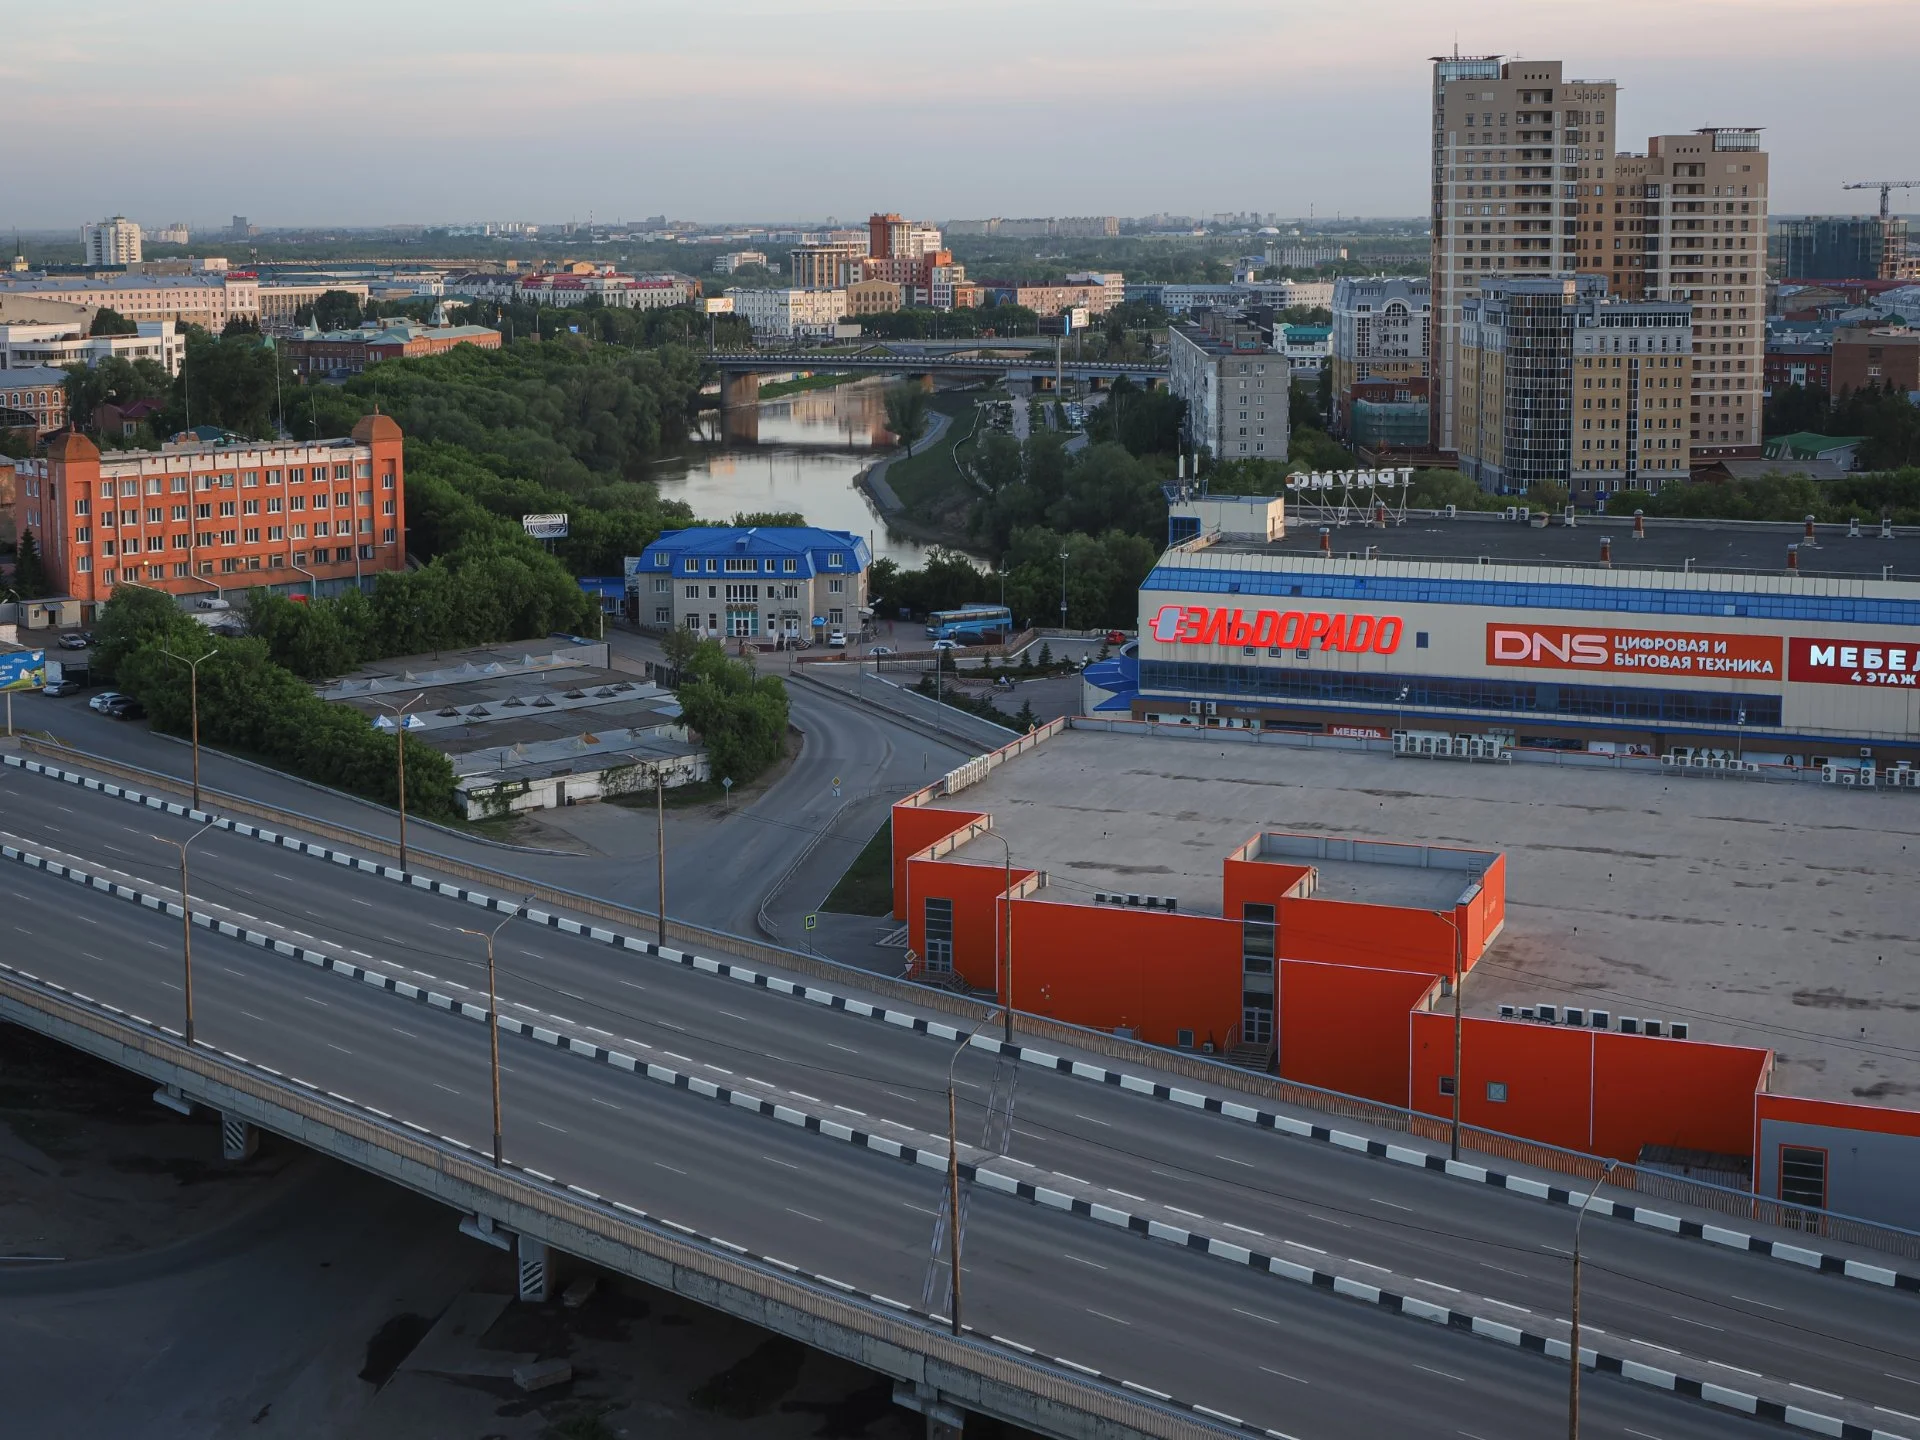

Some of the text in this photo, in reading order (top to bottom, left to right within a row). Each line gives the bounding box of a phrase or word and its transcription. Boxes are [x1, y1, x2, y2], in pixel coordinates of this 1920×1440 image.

[1494, 630, 1608, 665] DNS
[1614, 635, 1727, 654] ЦИФРОВАЯ И
[1614, 653, 1774, 673] БЫТОВАЯ ТЕХНИКА
[1851, 671, 1916, 685] 4 ЭТАЖ
[1333, 727, 1381, 738] МЕБЕЛЬ
